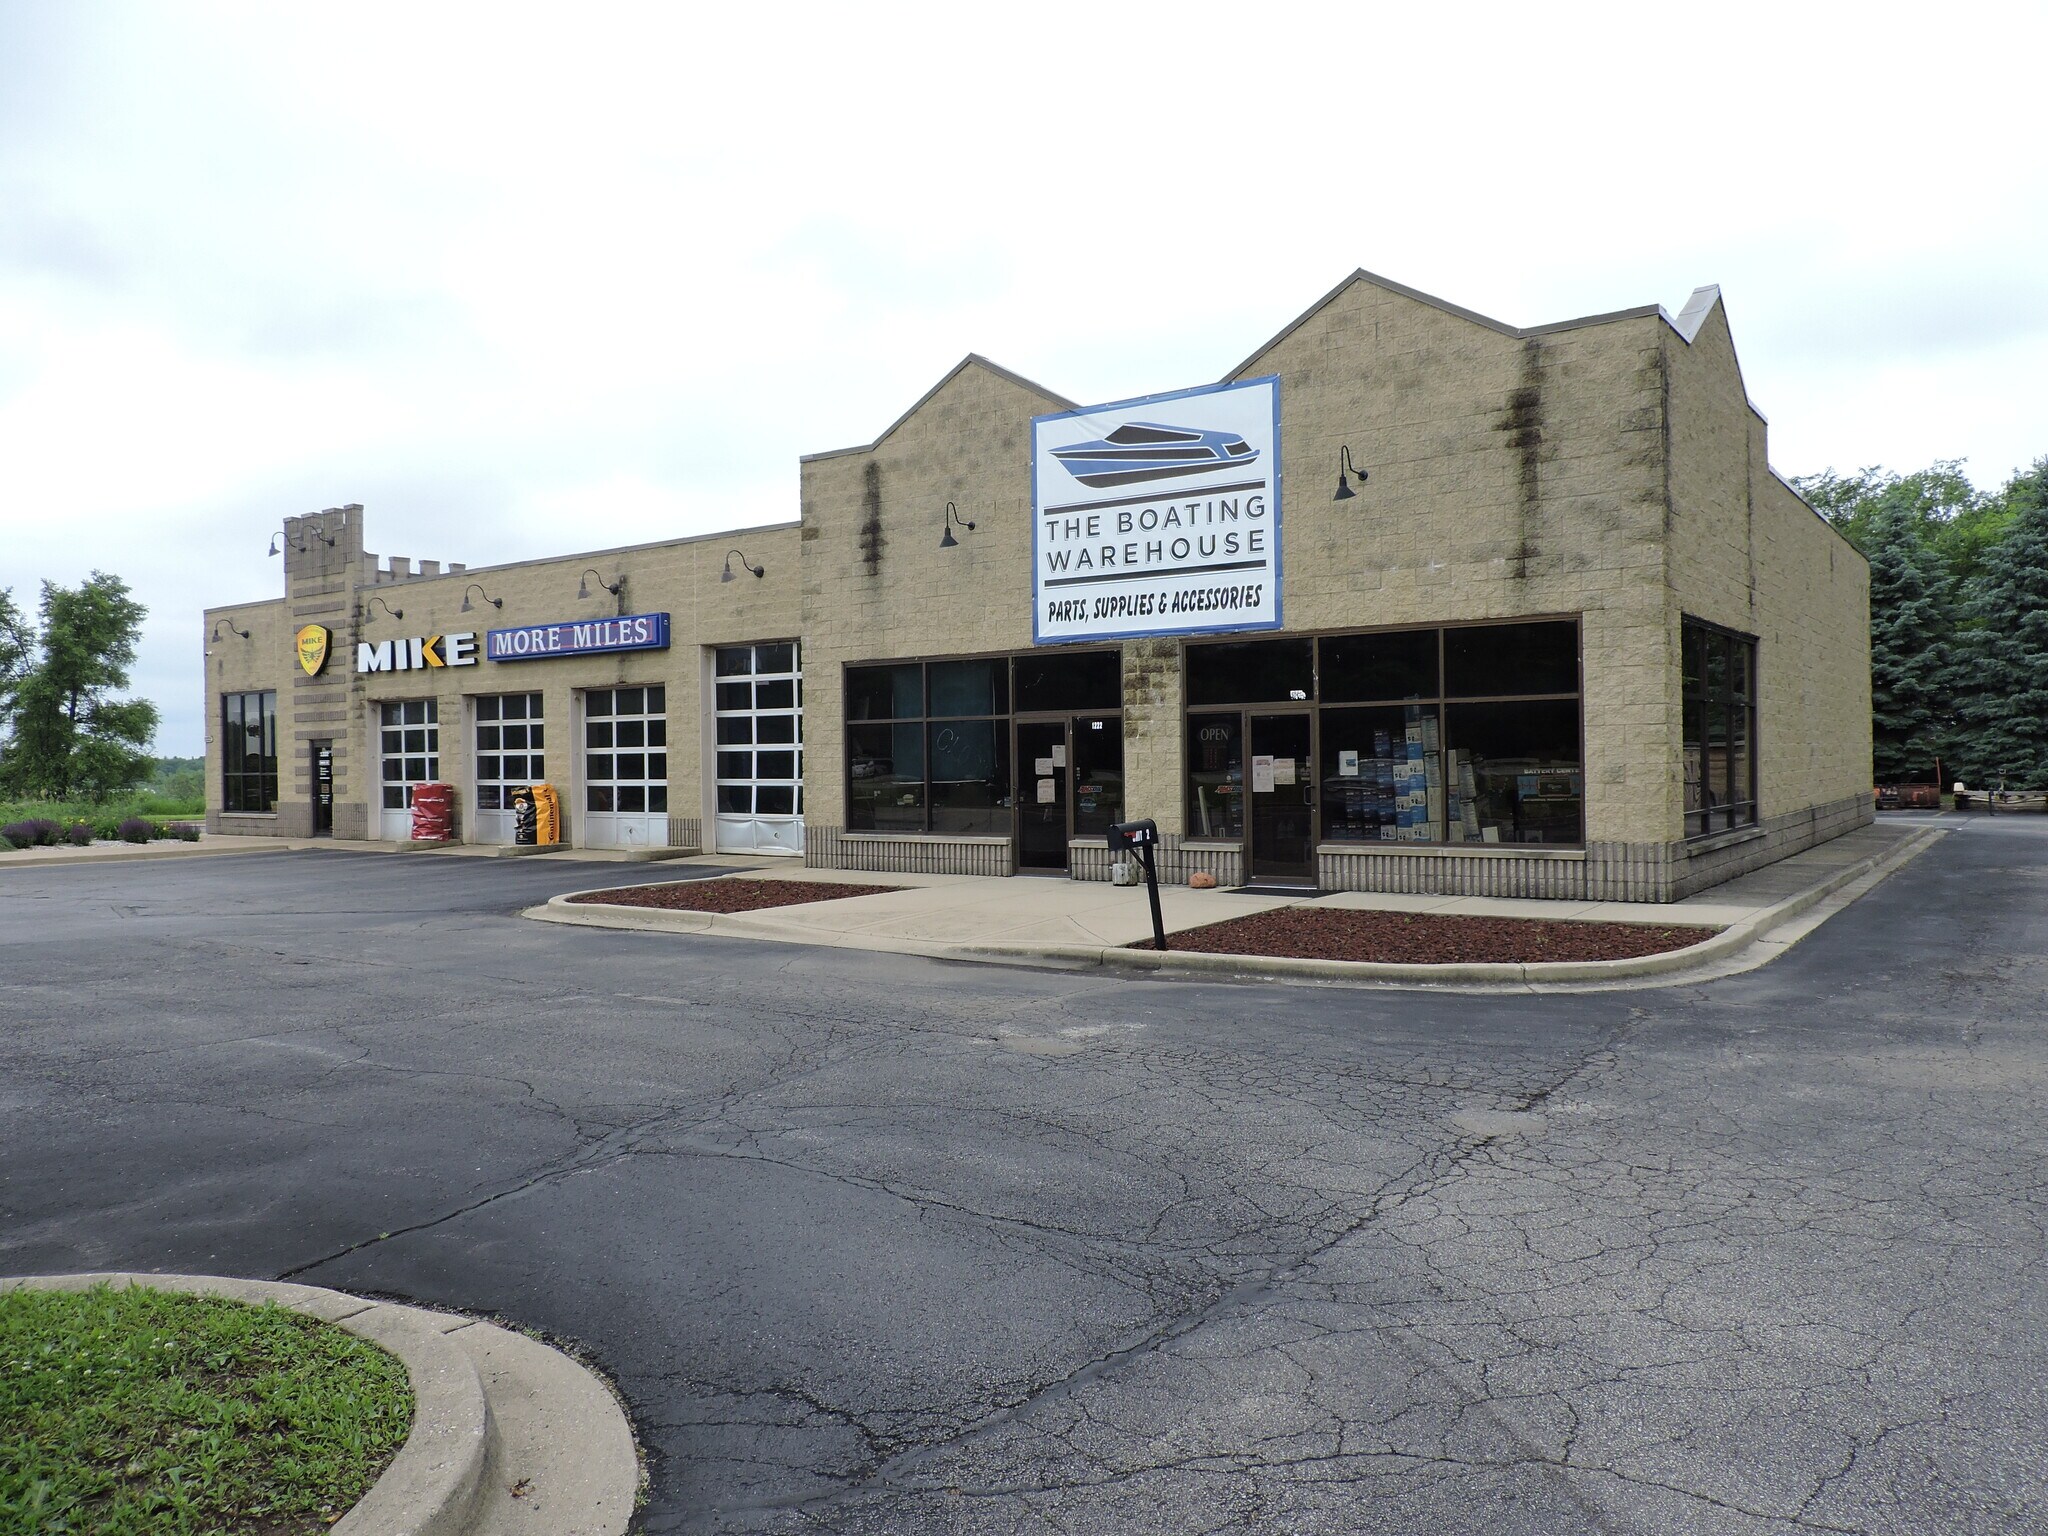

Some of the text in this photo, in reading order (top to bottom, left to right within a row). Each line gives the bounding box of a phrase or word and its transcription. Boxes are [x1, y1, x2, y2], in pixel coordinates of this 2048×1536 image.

[1045, 495, 1265, 542] THE BOATING
[1046, 529, 1265, 573] WAREHOUSE
[1048, 583, 1263, 623] PARTS, SUPPLIES & ACCESSORIES
[301, 636, 323, 645] MIKE
[358, 632, 478, 673] MIKE
[495, 618, 648, 656] MORE MILES
[1200, 728, 1230, 741] OPEN
